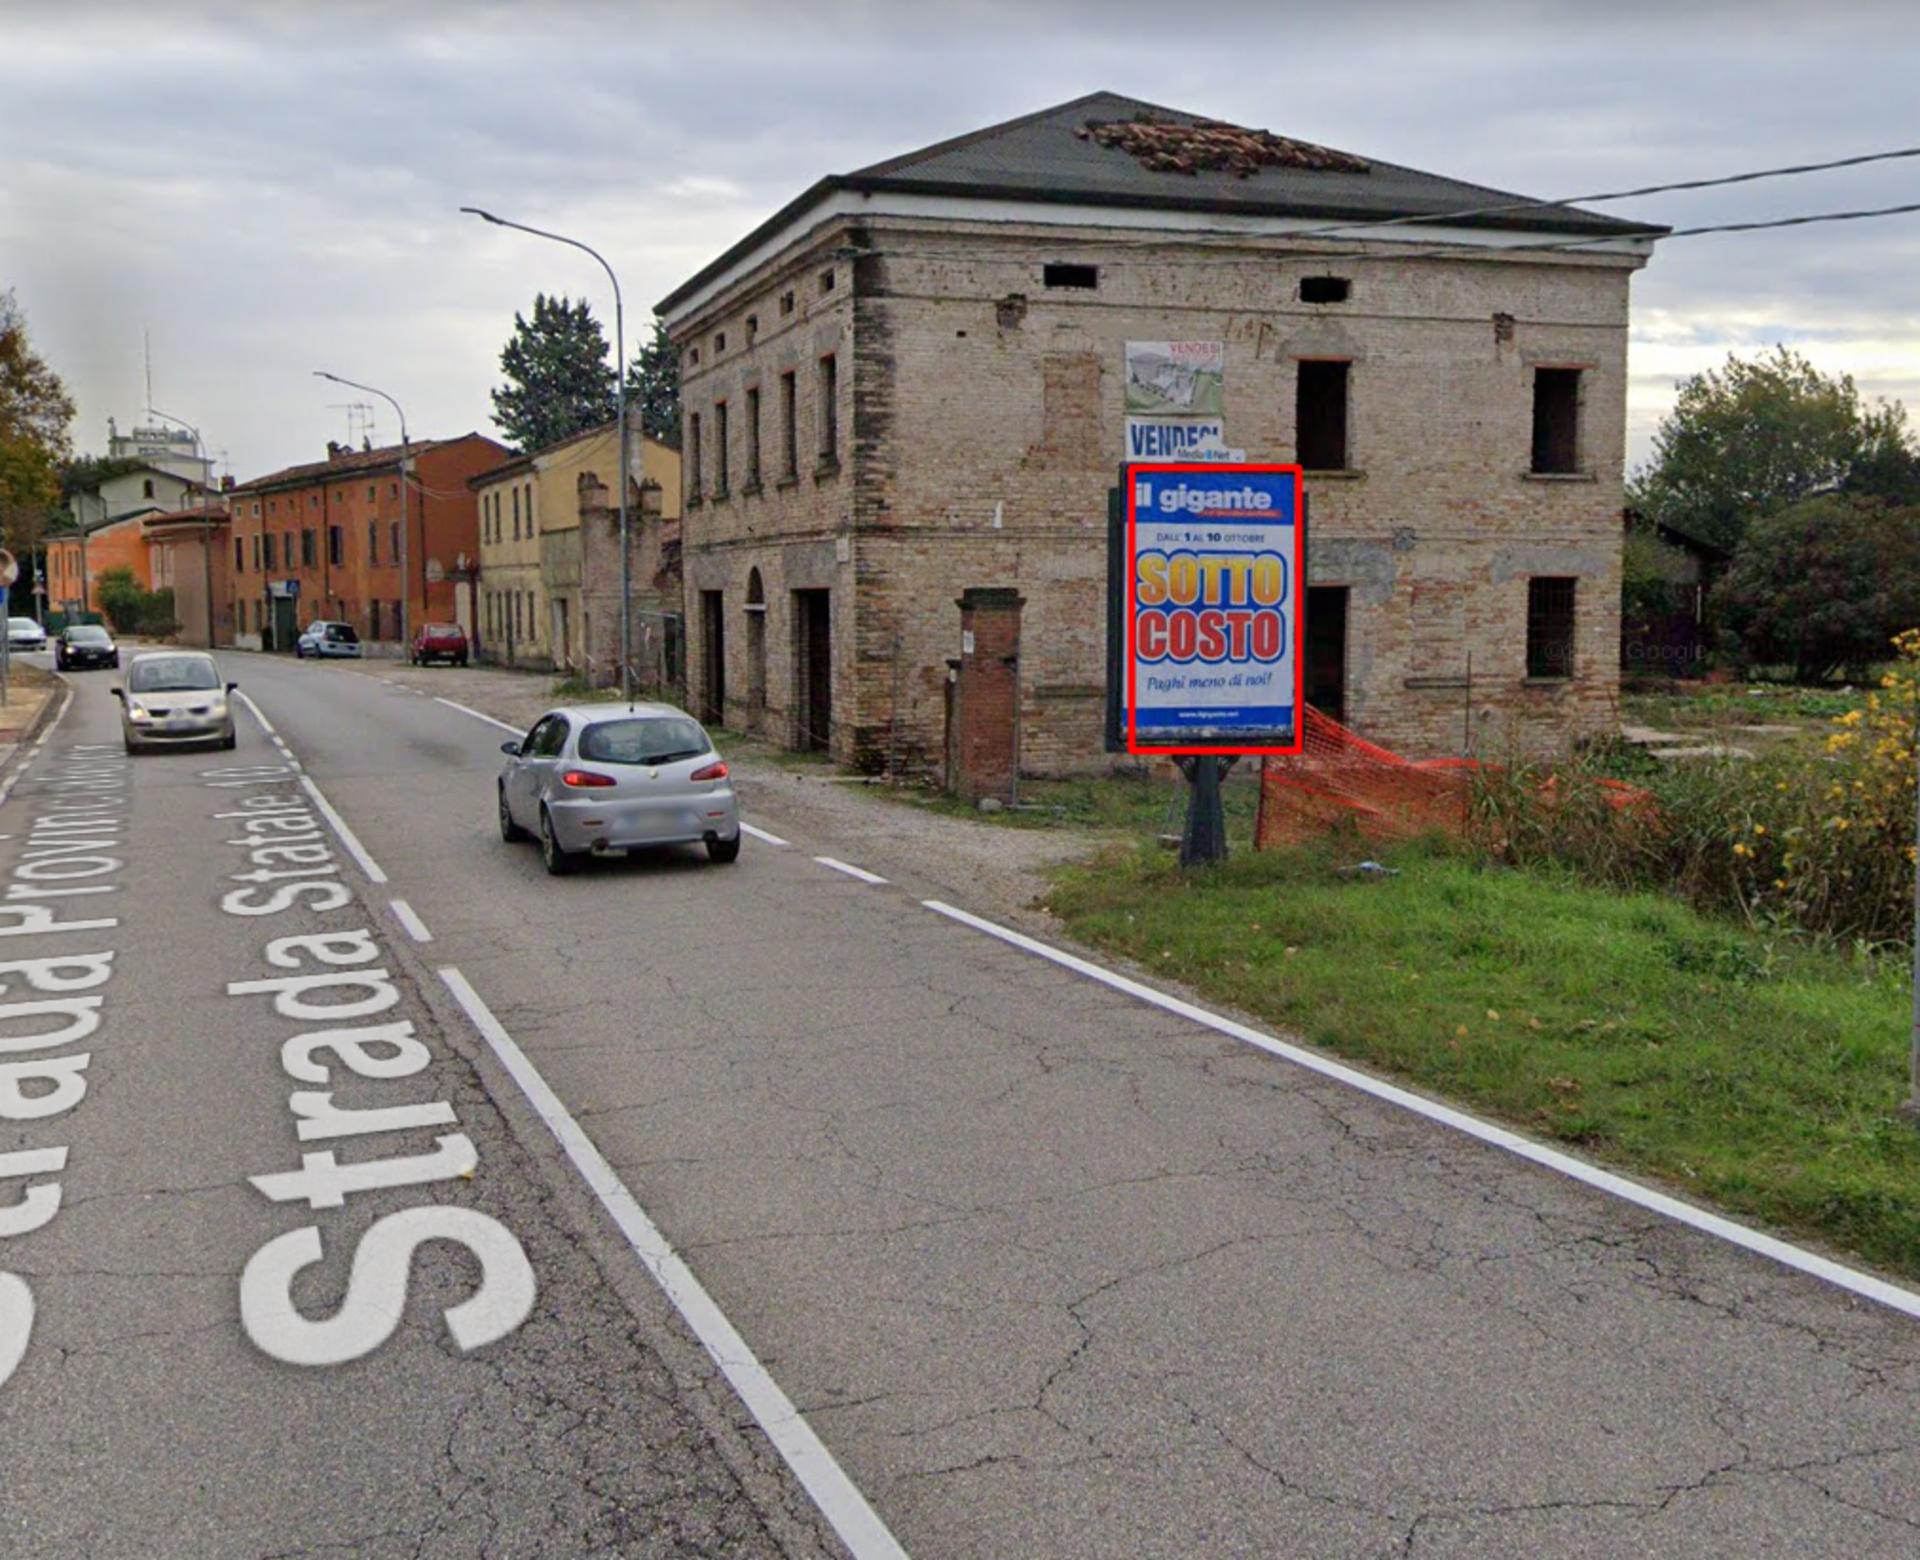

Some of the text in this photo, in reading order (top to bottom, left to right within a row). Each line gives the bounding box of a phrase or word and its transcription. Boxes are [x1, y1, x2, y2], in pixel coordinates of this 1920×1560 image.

[1135, 481, 1272, 513] il gigante
[1184, 532, 1191, 542] 1
[1193, 534, 1204, 543] AL
[1207, 532, 1222, 543] 10
[1223, 533, 1265, 544] OTTOBRE
[1136, 551, 1285, 607] SOTTO
[1136, 609, 1285, 661] COSTO
[1146, 672, 1273, 693] Paghi meno di noi!
